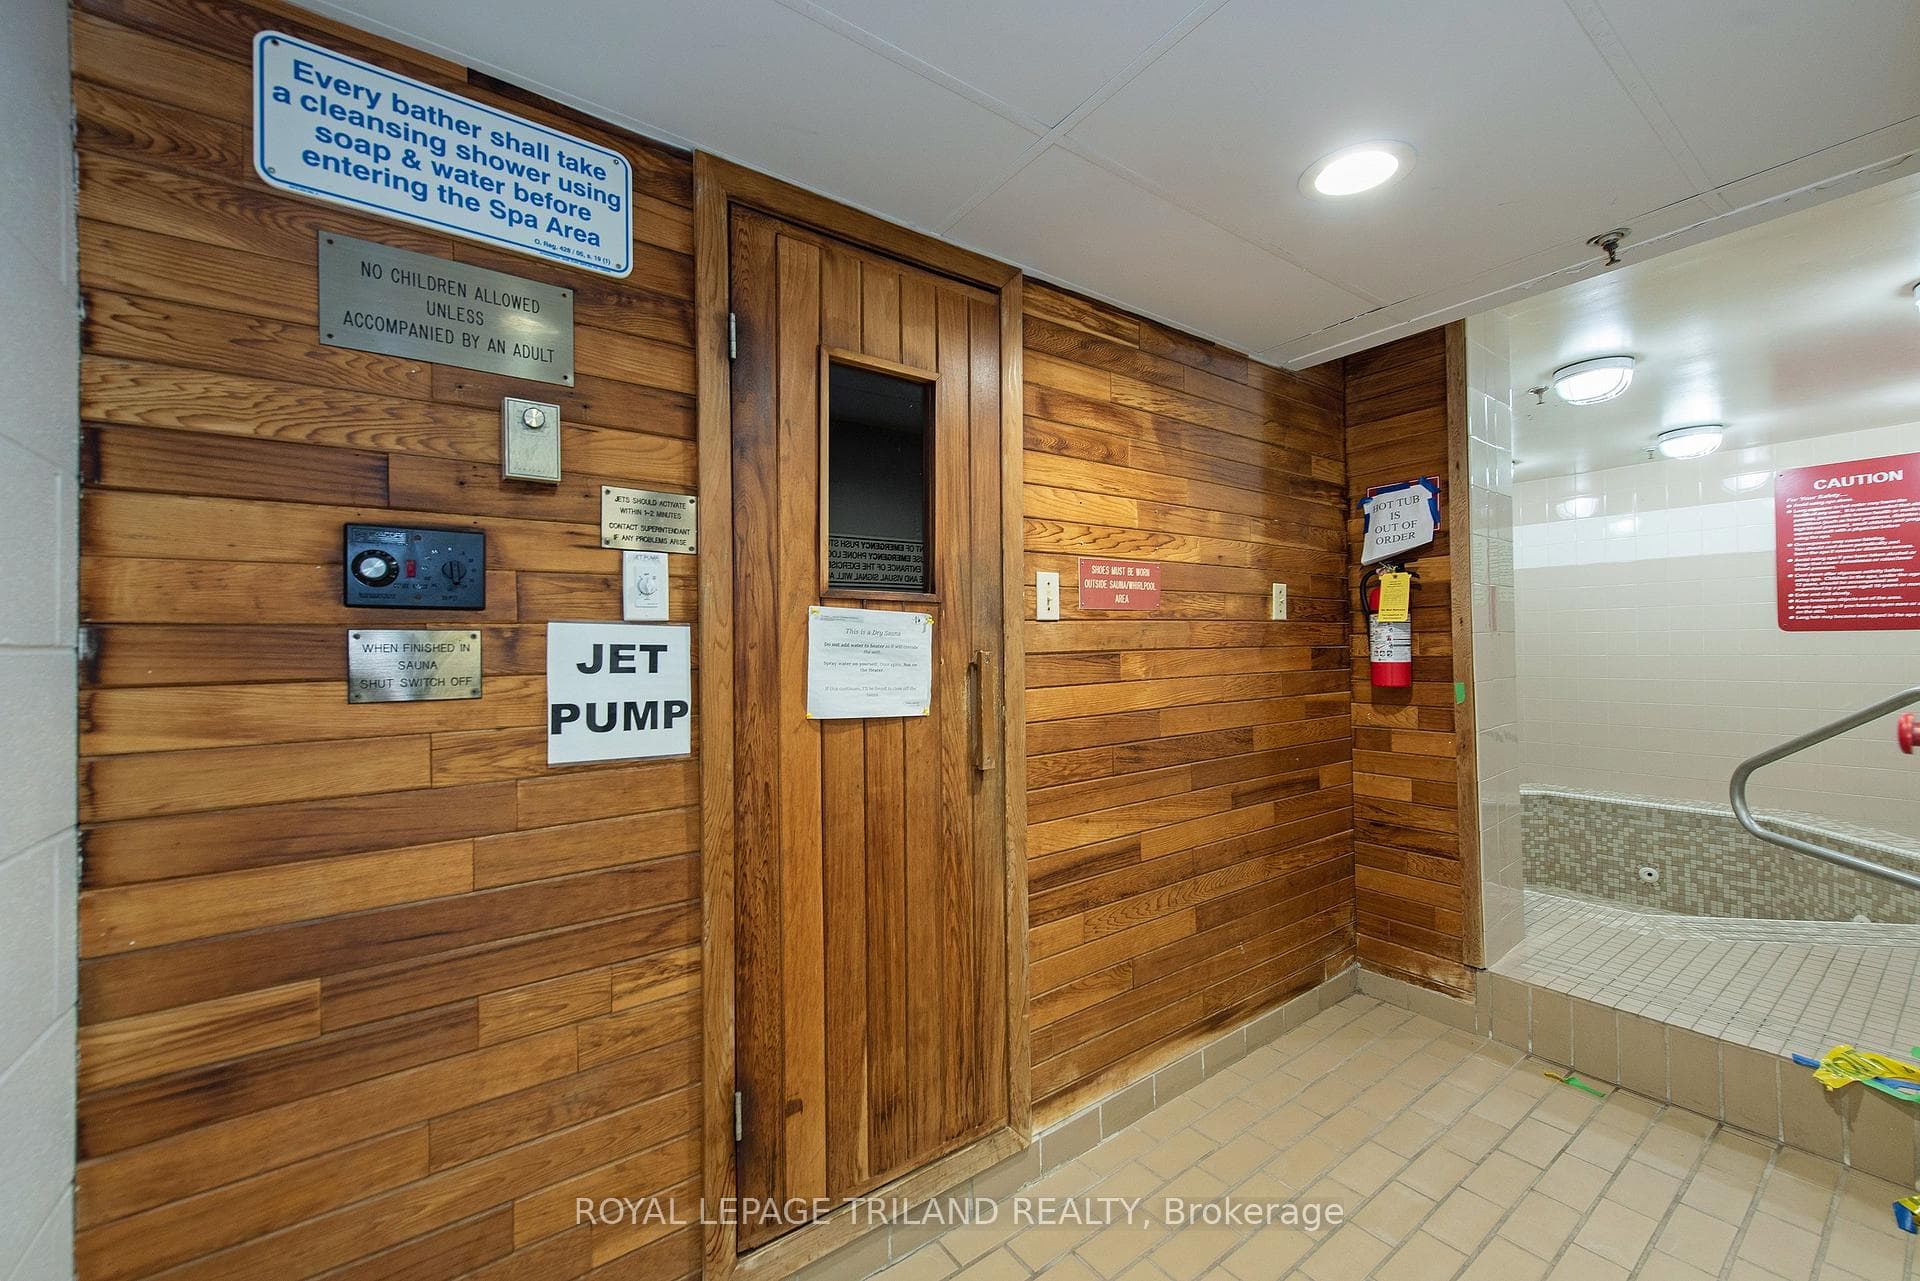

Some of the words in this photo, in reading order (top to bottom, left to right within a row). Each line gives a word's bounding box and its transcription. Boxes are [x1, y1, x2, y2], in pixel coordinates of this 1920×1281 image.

[292, 58, 382, 110] Every
[392, 93, 482, 139] bather
[490, 130, 550, 163] shall
[557, 150, 607, 181] take
[272, 85, 291, 105] a
[301, 91, 446, 158] cleansing
[456, 136, 550, 186] shower
[559, 176, 622, 212] using
[315, 126, 391, 165] soap
[402, 148, 422, 171] &
[431, 161, 506, 195] water
[513, 181, 592, 221] before
[301, 147, 429, 202] entering
[437, 181, 481, 212] the
[489, 199, 538, 229] Spa
[546, 217, 601, 247] Area
[543, 241, 558, 250] Reg.
[360, 261, 383, 280] NO
[391, 268, 467, 299] CHILDREN
[474, 286, 540, 314] ALLOWED
[426, 300, 485, 326] UNLESS
[343, 310, 454, 345] ACCOMPANIED
[462, 334, 481, 350] BY
[487, 338, 506, 355] AN
[513, 343, 555, 363] ADULT
[1813, 469, 1904, 491] CAUTION
[632, 497, 657, 506] SHOULD
[659, 500, 687, 510] ACTIVATE
[1372, 501, 1394, 513] HOT
[1397, 494, 1420, 507] TUB
[620, 507, 642, 516] WITHIN
[656, 511, 682, 520] MINUTES
[1390, 511, 1401, 520] IS
[609, 522, 638, 531] CONTACT
[1374, 523, 1399, 534] OUT
[1401, 520, 1418, 529] OF
[636, 535, 668, 545] PROBLEMS
[1375, 531, 1416, 545] ORDER
[1091, 565, 1110, 575] SHOES
[1111, 566, 1126, 576] MUST
[1127, 567, 1134, 576] BE
[1135, 568, 1150, 577] WORN
[1084, 579, 1108, 589] OUTSIDE
[1109, 580, 1156, 591] SAUNA/WHIRLPOOL
[1115, 594, 1130, 604] AREA
[362, 643, 399, 653] WHEN
[402, 643, 455, 653] FINISHED
[460, 644, 471, 652] IN
[398, 661, 438, 670] SAUNA
[576, 643, 668, 675] JET
[360, 679, 393, 689] SHUT
[400, 677, 445, 688] SWITCH
[450, 676, 473, 686] OFF
[551, 700, 689, 735] PUMP
